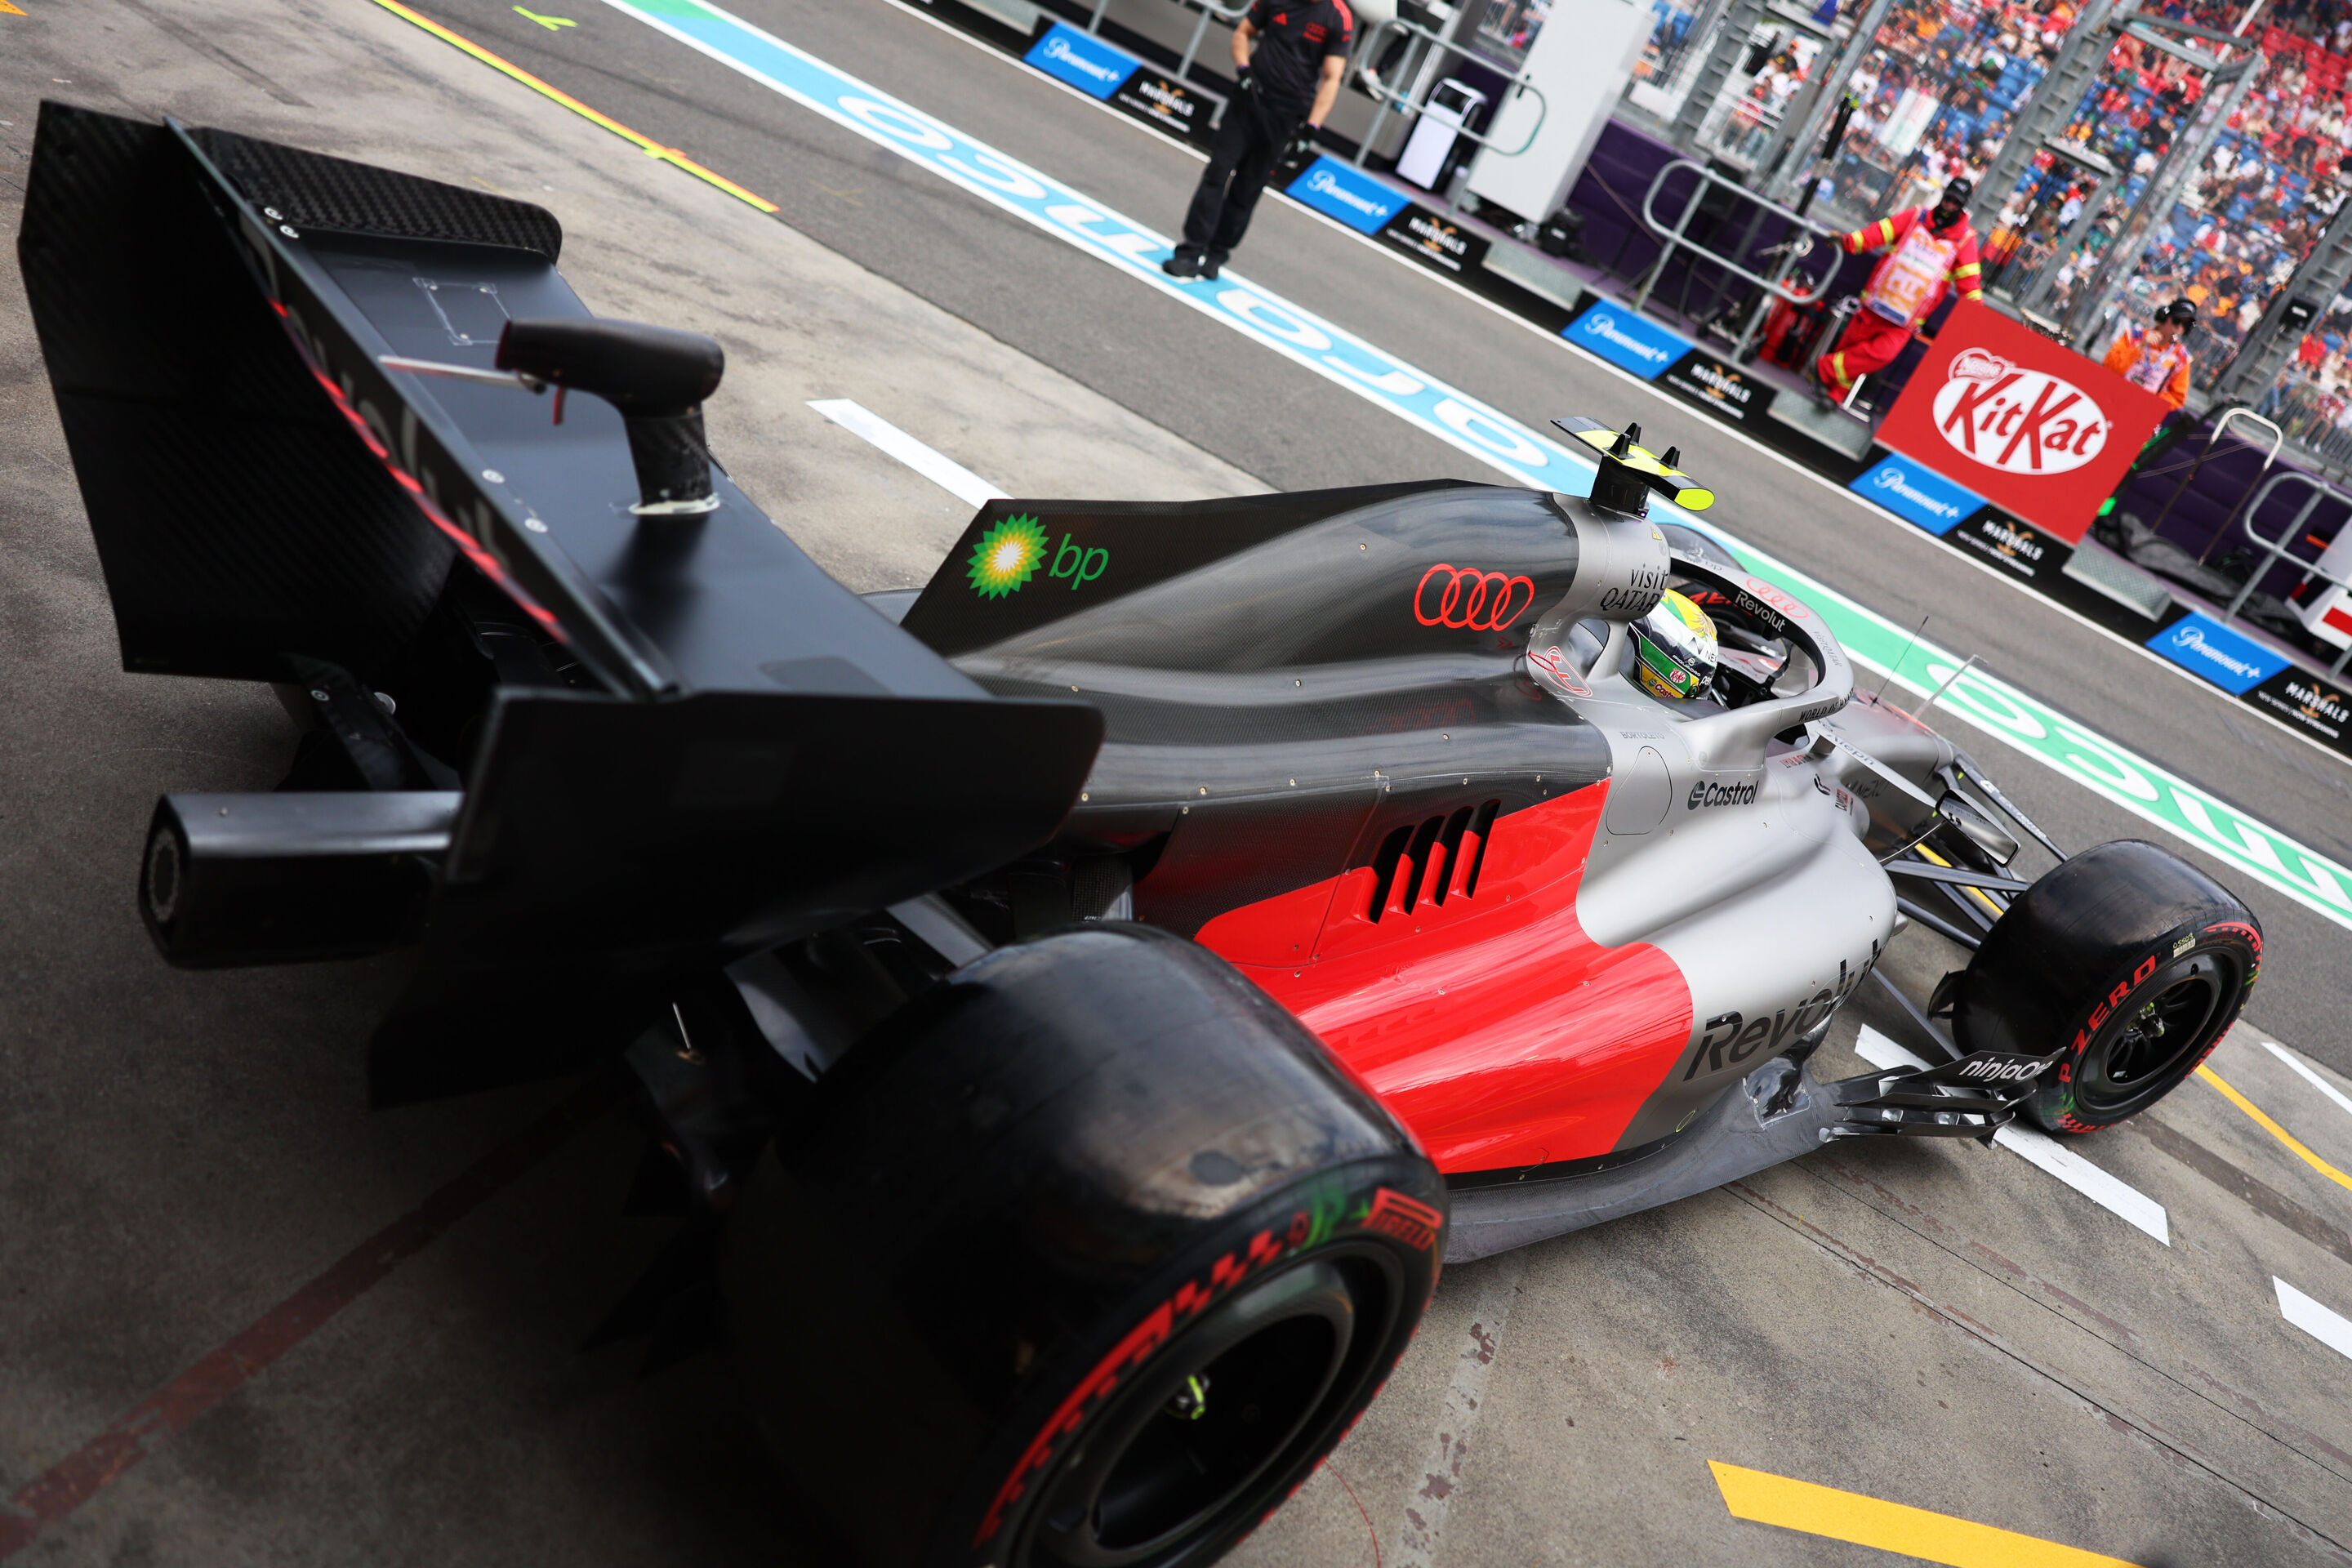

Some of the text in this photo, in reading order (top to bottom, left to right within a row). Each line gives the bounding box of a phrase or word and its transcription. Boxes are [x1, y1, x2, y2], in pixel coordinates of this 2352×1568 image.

[1043, 37, 1120, 82] Paramount+
[1307, 170, 1388, 217] Paramount+
[1584, 314, 1668, 363] Paramount+
[1944, 372, 2102, 470] KitKat
[1873, 467, 1959, 518] Paramount+
[1049, 533, 1109, 590] bp
[1982, 519, 2044, 561] MARSHALS
[1600, 587, 1660, 612] QATAR
[1630, 563, 1668, 590] visit
[1735, 590, 1787, 633] Revolut
[2172, 626, 2261, 679] Paramount+
[1655, 684, 1677, 698] Castr
[2285, 681, 2350, 723] MARSHALS
[1704, 780, 1760, 808] Castrol
[1682, 938, 1882, 1082] Revolut
[2058, 955, 2157, 1083] P ZERO
